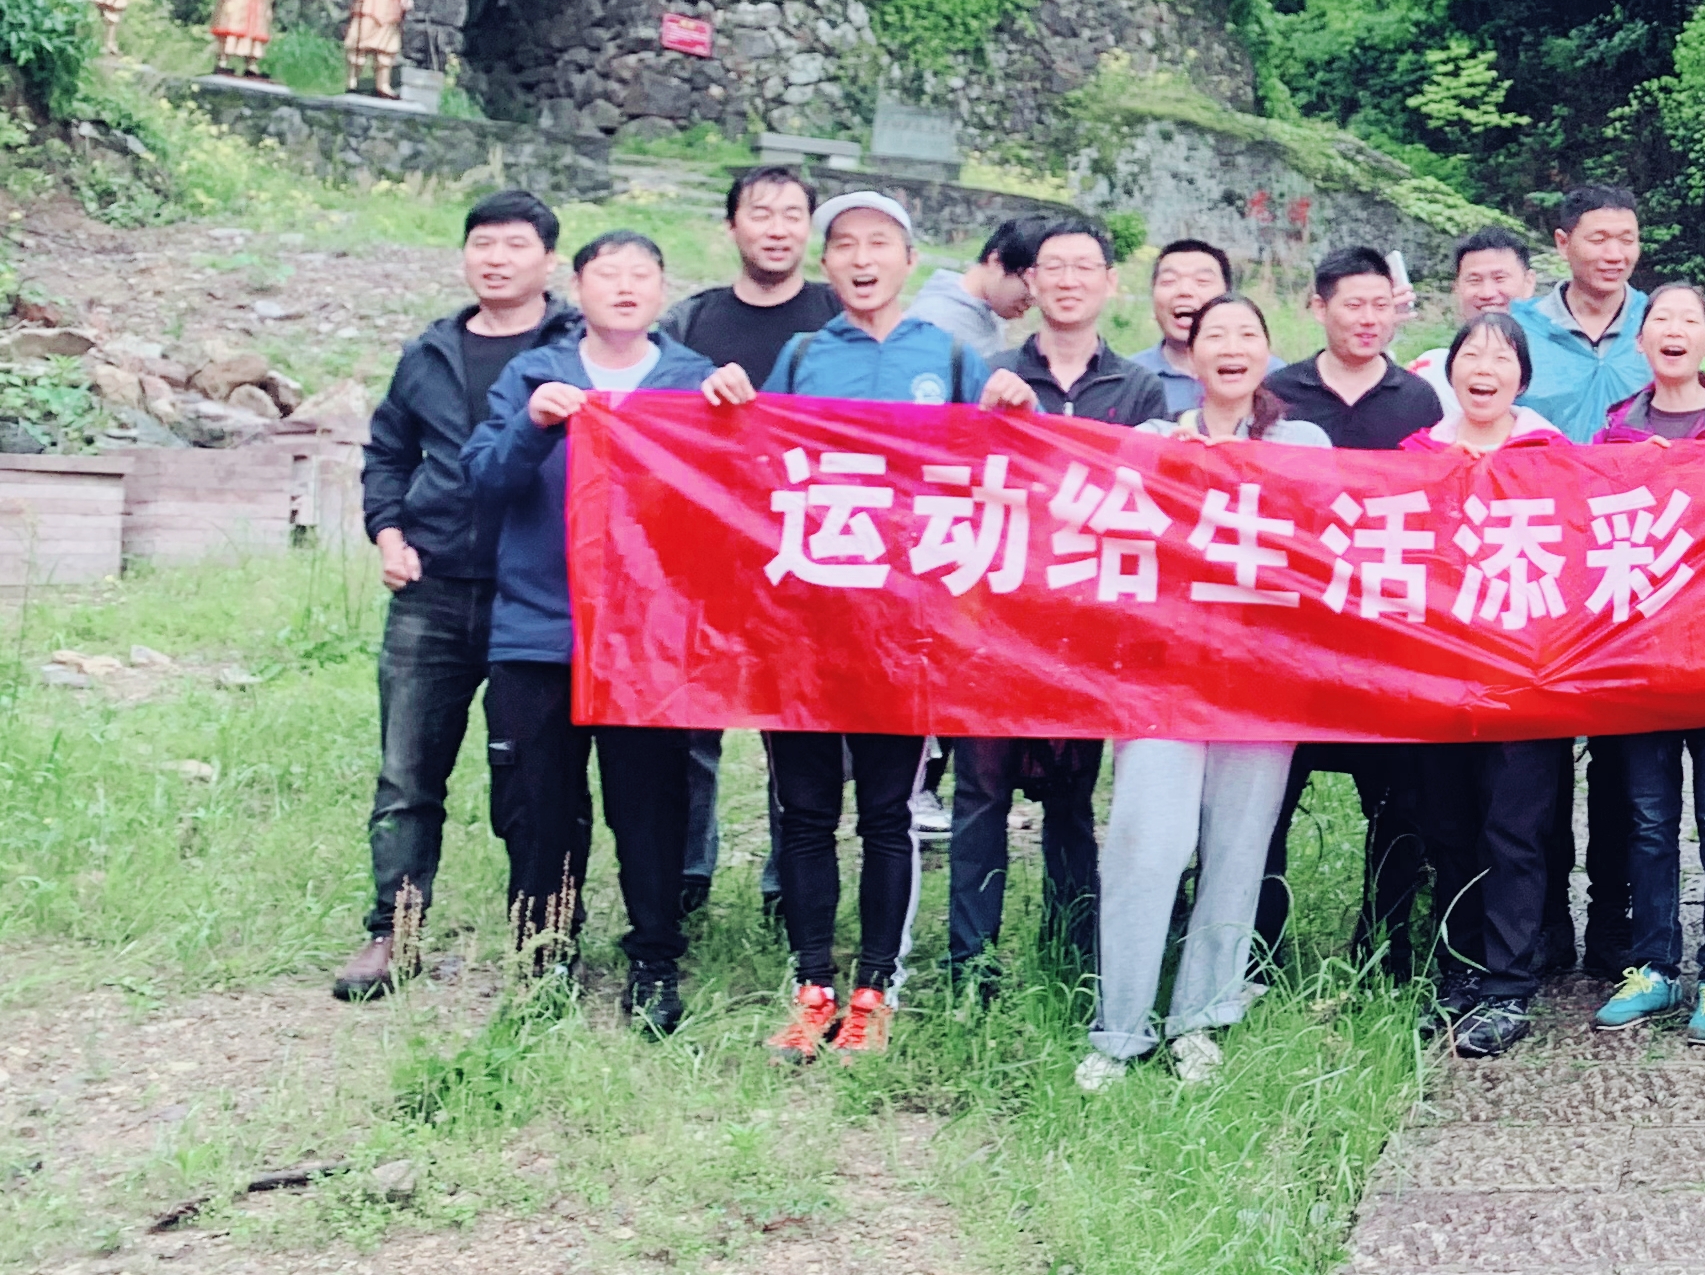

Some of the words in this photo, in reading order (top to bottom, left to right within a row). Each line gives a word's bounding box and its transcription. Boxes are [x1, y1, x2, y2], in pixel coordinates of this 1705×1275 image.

[764, 446, 1696, 631] 运动给生活添彩
